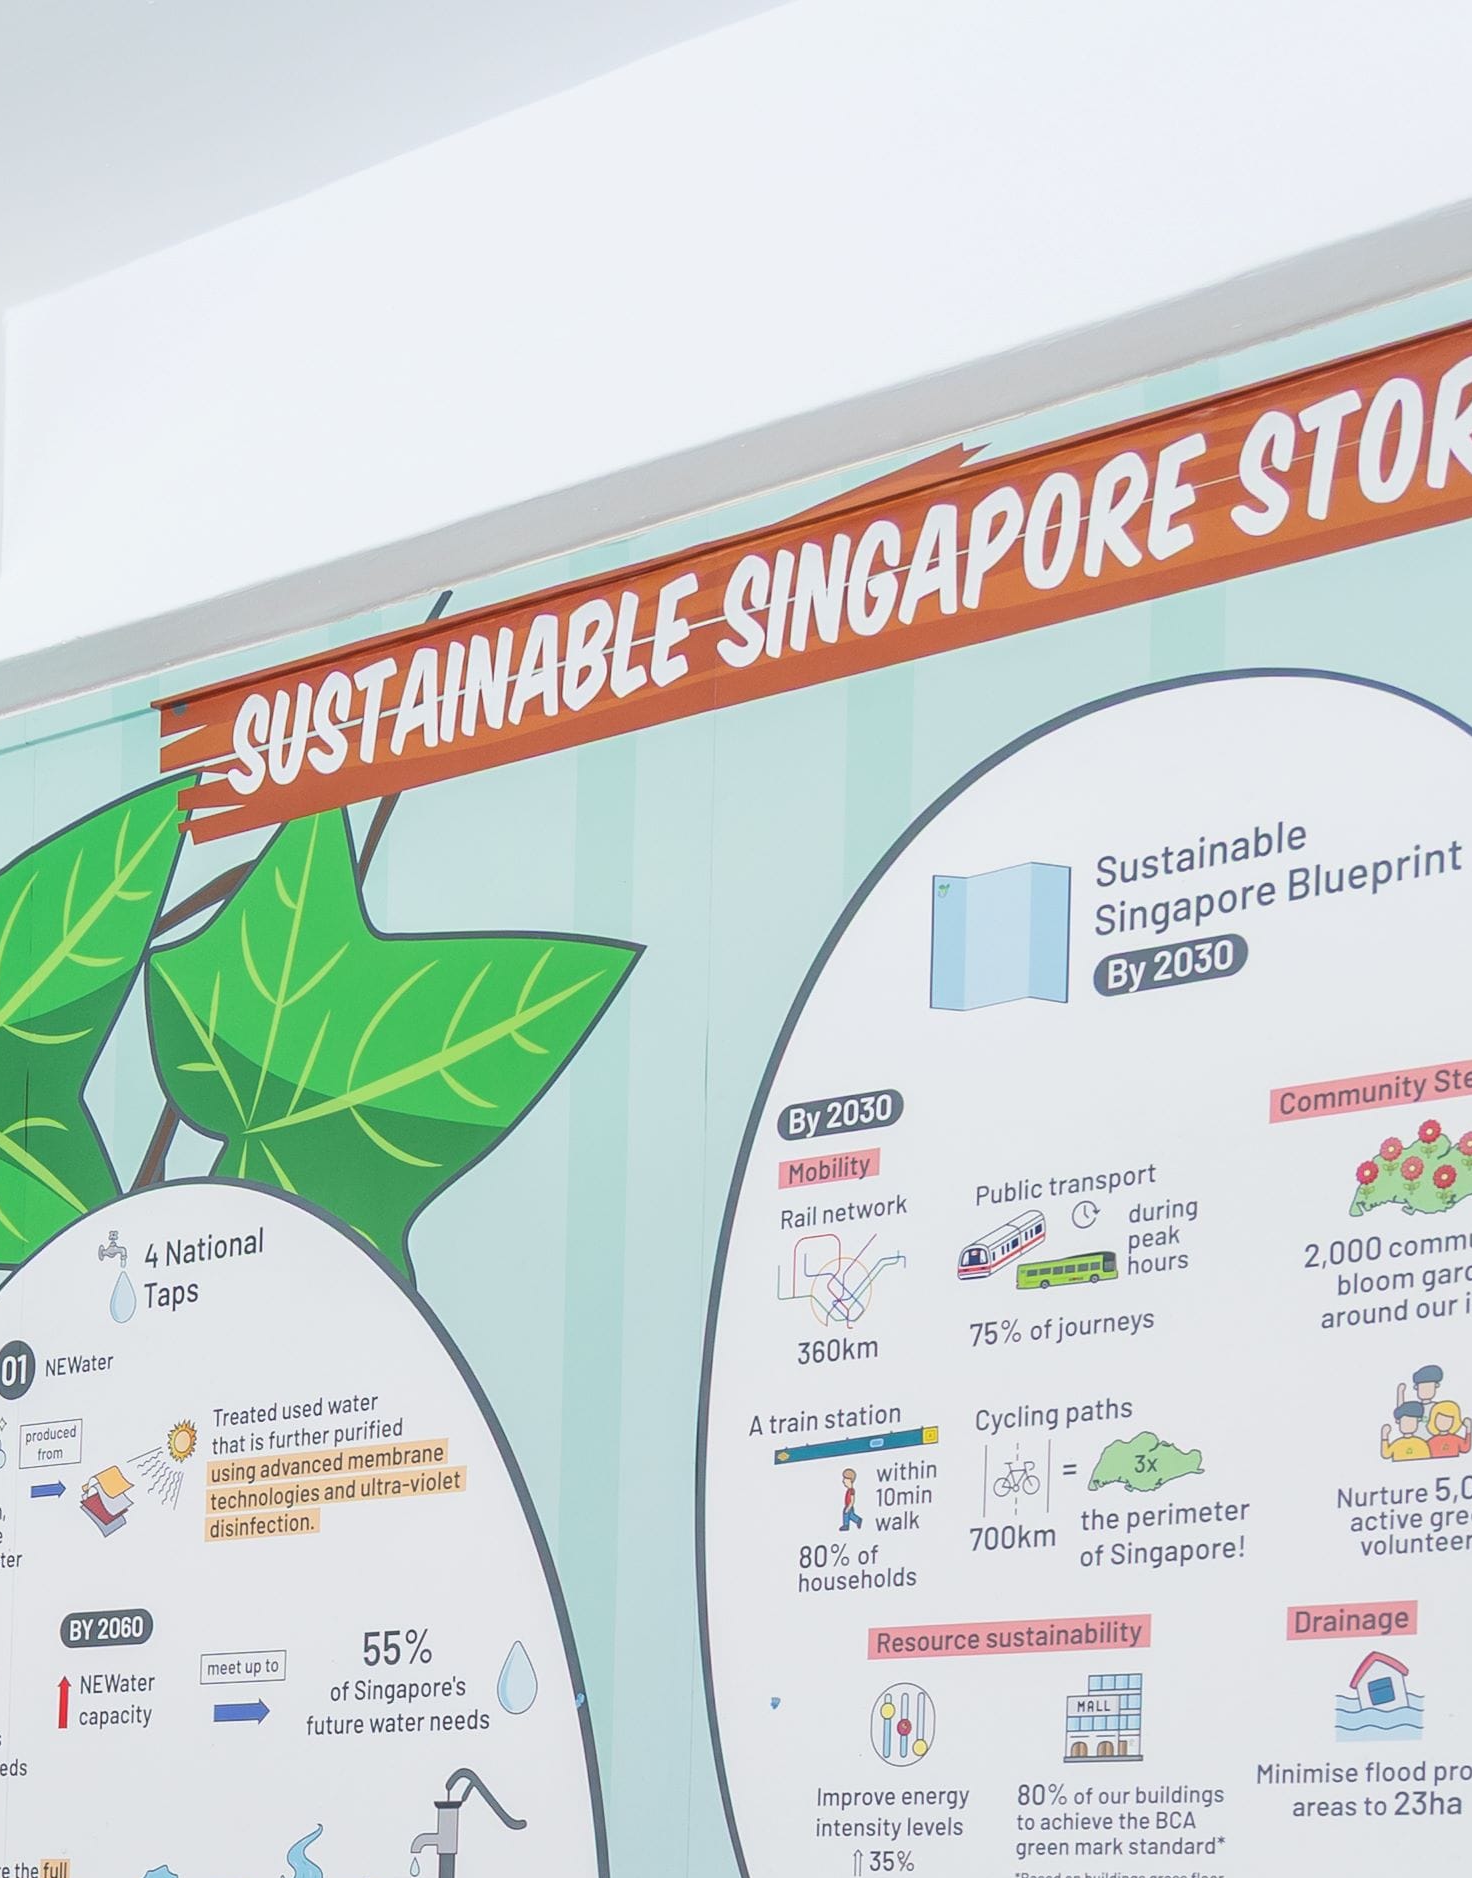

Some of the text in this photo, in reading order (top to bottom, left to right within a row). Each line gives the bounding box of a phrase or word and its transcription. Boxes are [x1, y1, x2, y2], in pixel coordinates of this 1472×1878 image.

[230, 572, 696, 795] SUSTAINABLE
[716, 432, 1208, 670] SINGAPORE
[1097, 821, 1306, 887] Sustainable
[1096, 841, 1462, 936] Singapore Blueprint
[1107, 940, 1235, 995] By 2030
[787, 1091, 893, 1138] By 2030
[1278, 1075, 1426, 1118] Community
[789, 1153, 870, 1186] Mobility
[977, 1164, 1156, 1206] Public transport
[782, 1194, 906, 1230] Rail network
[145, 1227, 263, 1268] 4 National
[145, 1279, 199, 1311] Taps
[1, 1353, 113, 1386] 01 NEWater
[798, 1338, 877, 1365] 360km
[214, 1395, 378, 1427] Treated used water
[976, 1398, 1132, 1435] Cycling paths
[1134, 1453, 1158, 1474] 3x
[970, 1525, 1055, 1551] 700km
[70, 1616, 144, 1641] BY 2060
[876, 1618, 1142, 1655] Resource sustainability
[1293, 1605, 1409, 1637] Drainage
[361, 1629, 433, 1666] 55%
[331, 1676, 465, 1704] of Singapore's
[1077, 1698, 1112, 1714] MALL
